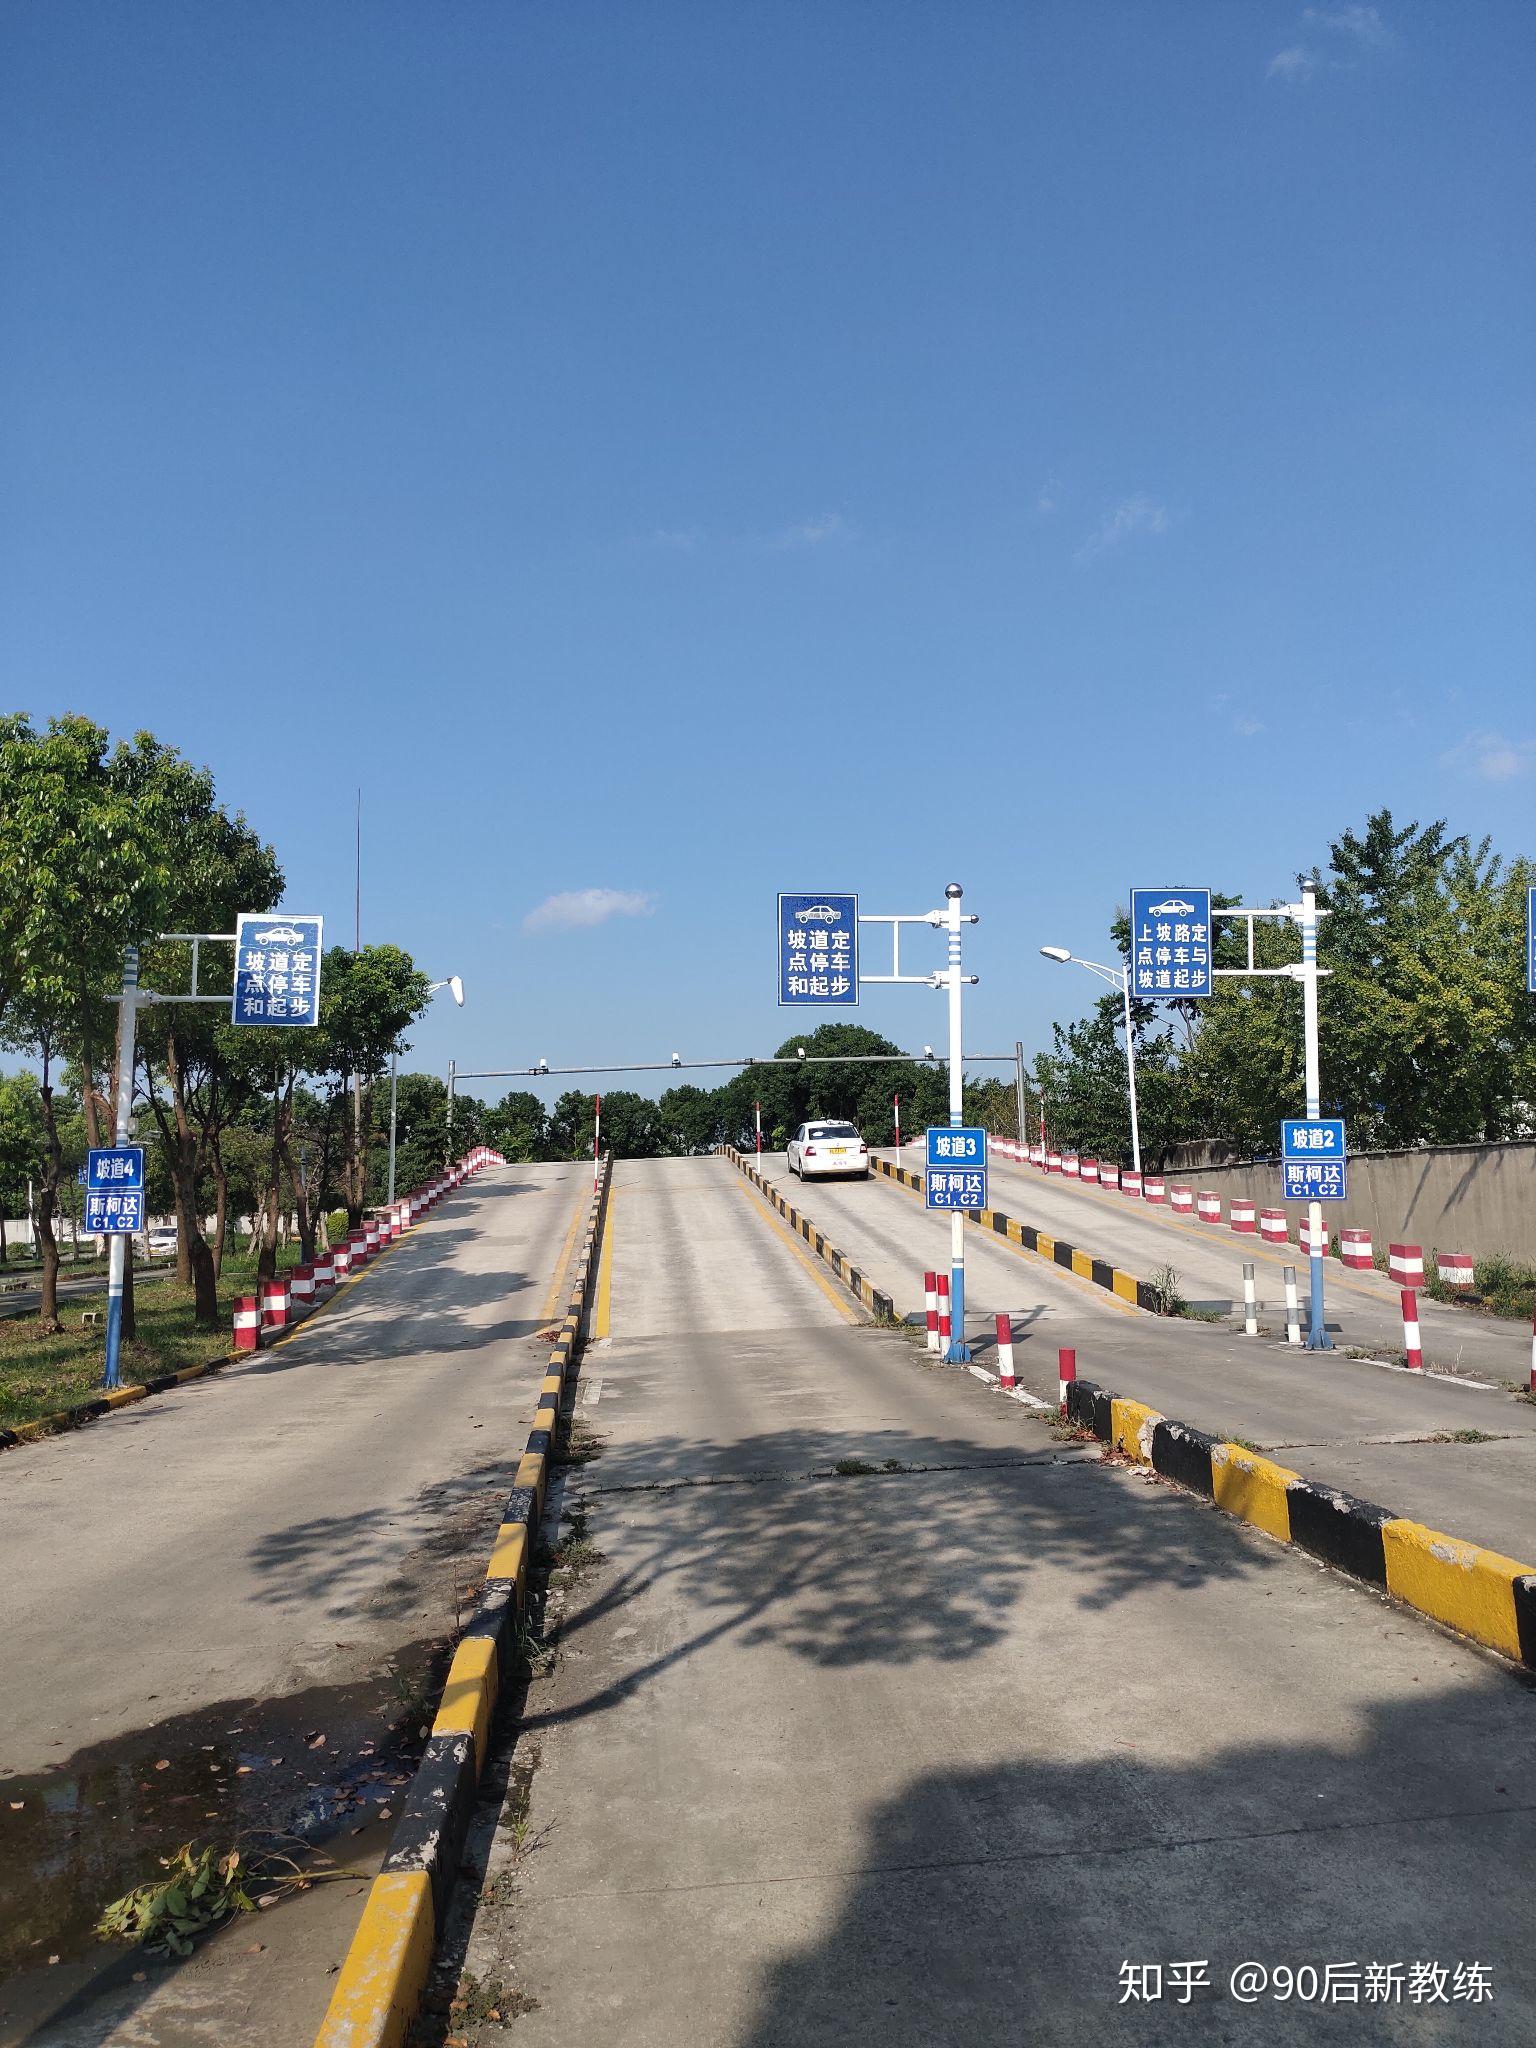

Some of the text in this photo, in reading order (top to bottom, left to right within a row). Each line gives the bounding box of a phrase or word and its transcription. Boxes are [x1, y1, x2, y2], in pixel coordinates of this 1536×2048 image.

[788, 930, 850, 950] 坡道定
[1138, 923, 1207, 942] 上坡路定
[246, 951, 312, 972] 坡道定
[788, 952, 851, 972] 点停车
[1138, 947, 1207, 966] 点停车与
[245, 974, 311, 995] 点停车
[788, 975, 851, 996] 和起步
[1138, 969, 1207, 989] 坡道起步
[243, 997, 311, 1017] 和起步
[936, 1135, 977, 1157] 坡道3
[1293, 1128, 1335, 1149] 坡道2
[96, 1157, 135, 1179] 坡道4
[1287, 1165, 1341, 1183] 斯柯达
[930, 1173, 982, 1193] 斯柯达
[89, 1196, 138, 1216] 斯柯达
